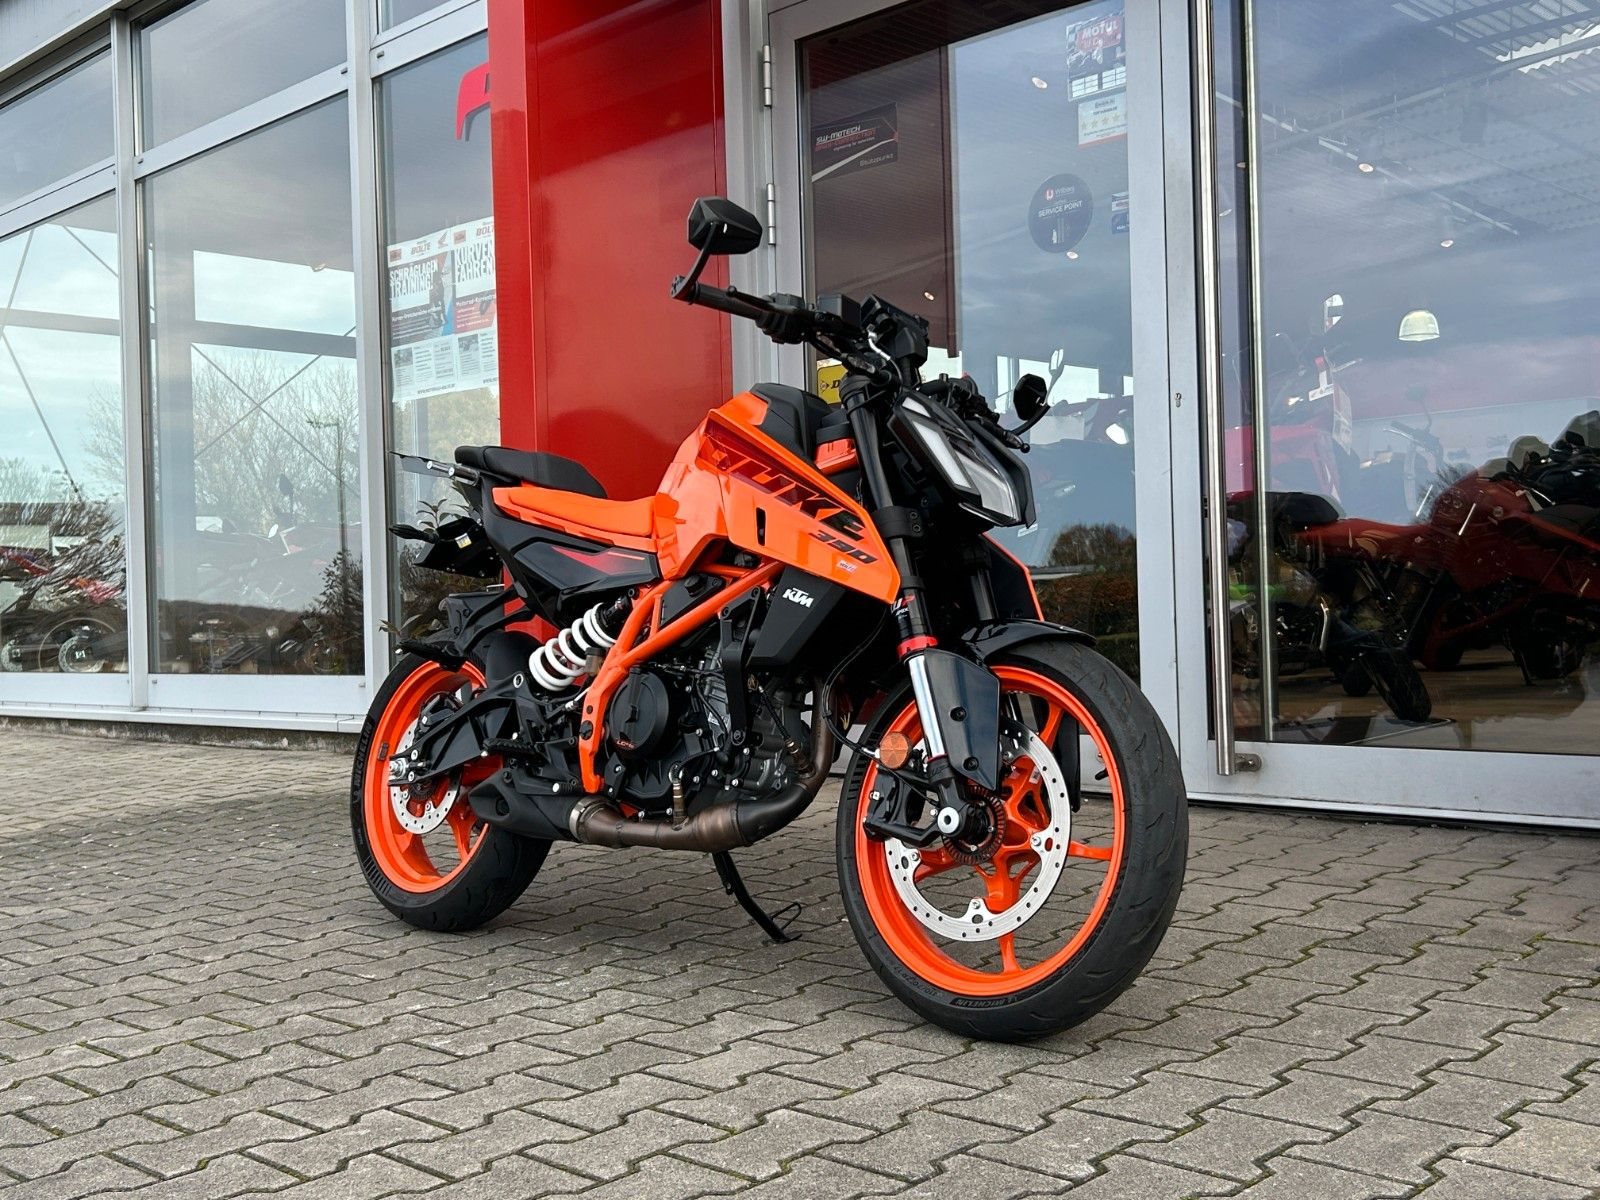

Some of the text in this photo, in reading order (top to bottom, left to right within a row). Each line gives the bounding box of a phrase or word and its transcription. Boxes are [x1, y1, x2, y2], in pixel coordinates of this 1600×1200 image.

[1082, 20, 1120, 41] MOTUL
[816, 125, 861, 143] SW-MOTECH
[1038, 200, 1082, 217] SERVICE POINT
[455, 240, 494, 265] KURVEN
[456, 257, 494, 283] FAHREN
[698, 434, 866, 542] DUKE
[808, 530, 878, 564] 390
[782, 588, 814, 608] KTM
[354, 722, 372, 786] MICHELIN
[955, 998, 1006, 1008] MICHELIN
